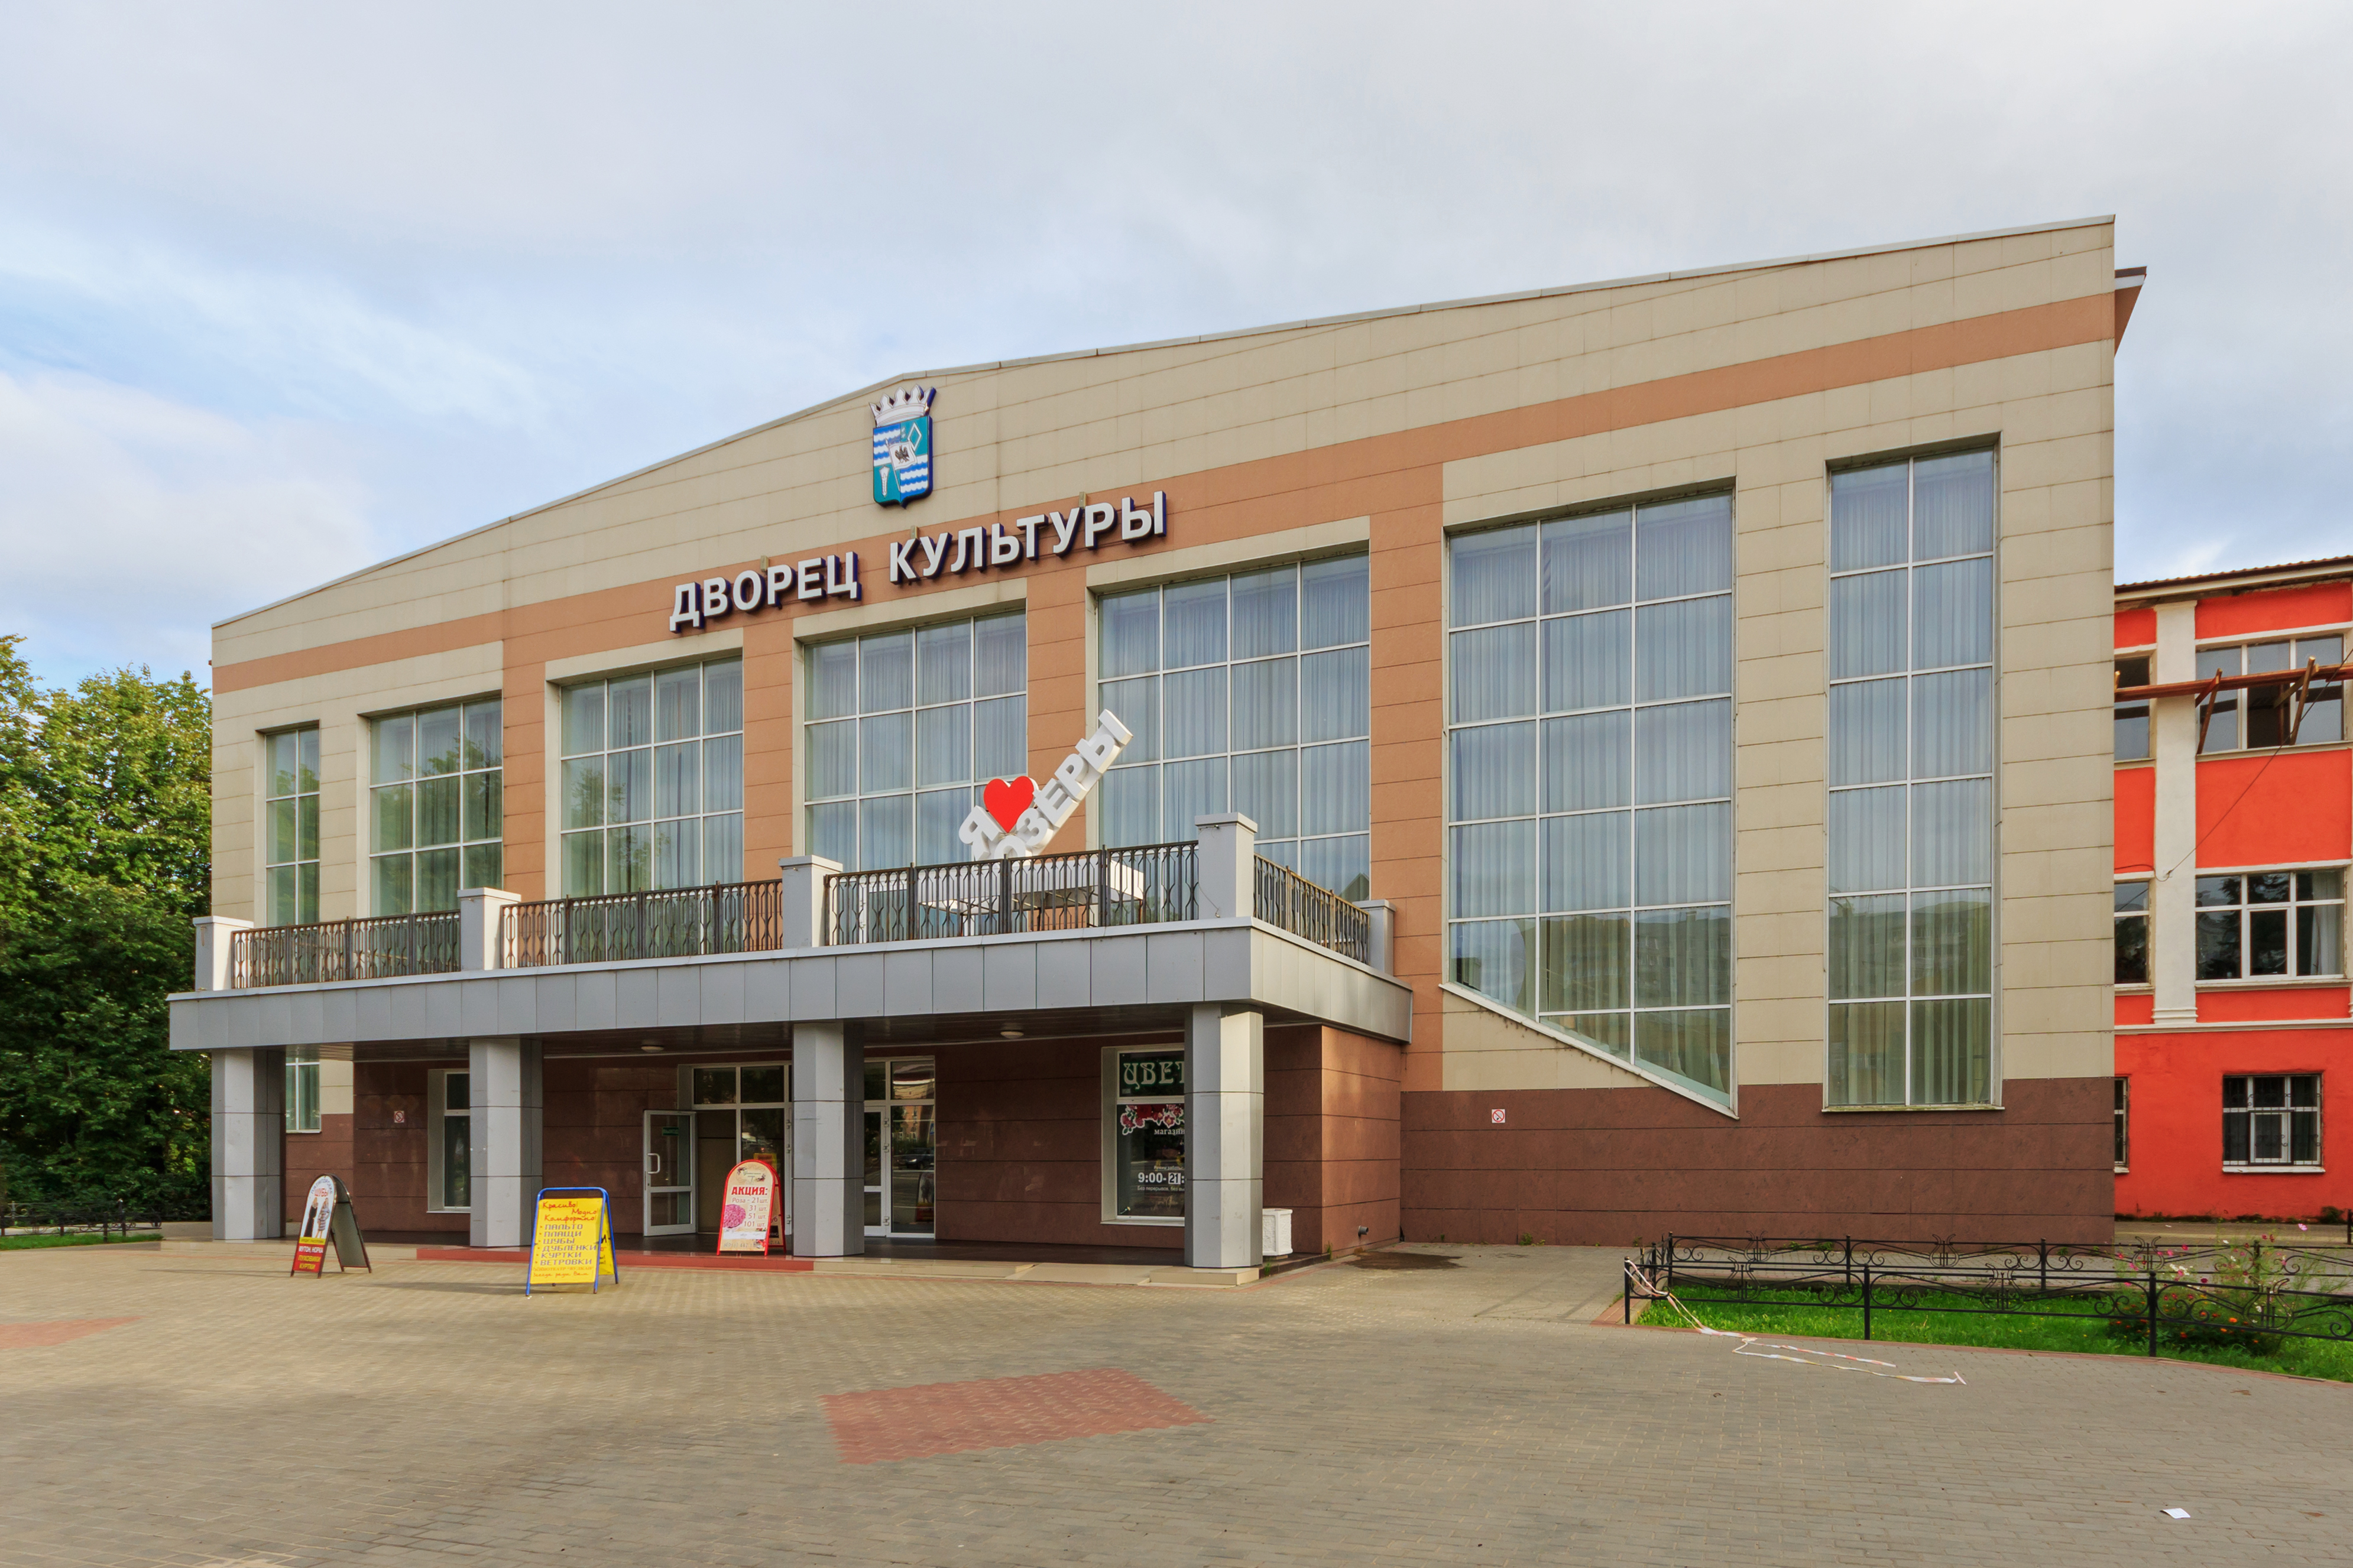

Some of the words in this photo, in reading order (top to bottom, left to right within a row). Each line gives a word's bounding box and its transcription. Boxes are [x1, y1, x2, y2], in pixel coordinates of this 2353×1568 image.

[669, 551, 862, 634] ДВОРЕЦ
[889, 491, 1167, 585] КУЛЬТУРЫ
[958, 805, 1002, 861] Я
[994, 709, 1133, 862] ОЗЕРЫ
[731, 1187, 767, 1196] АКЦИЯ:
